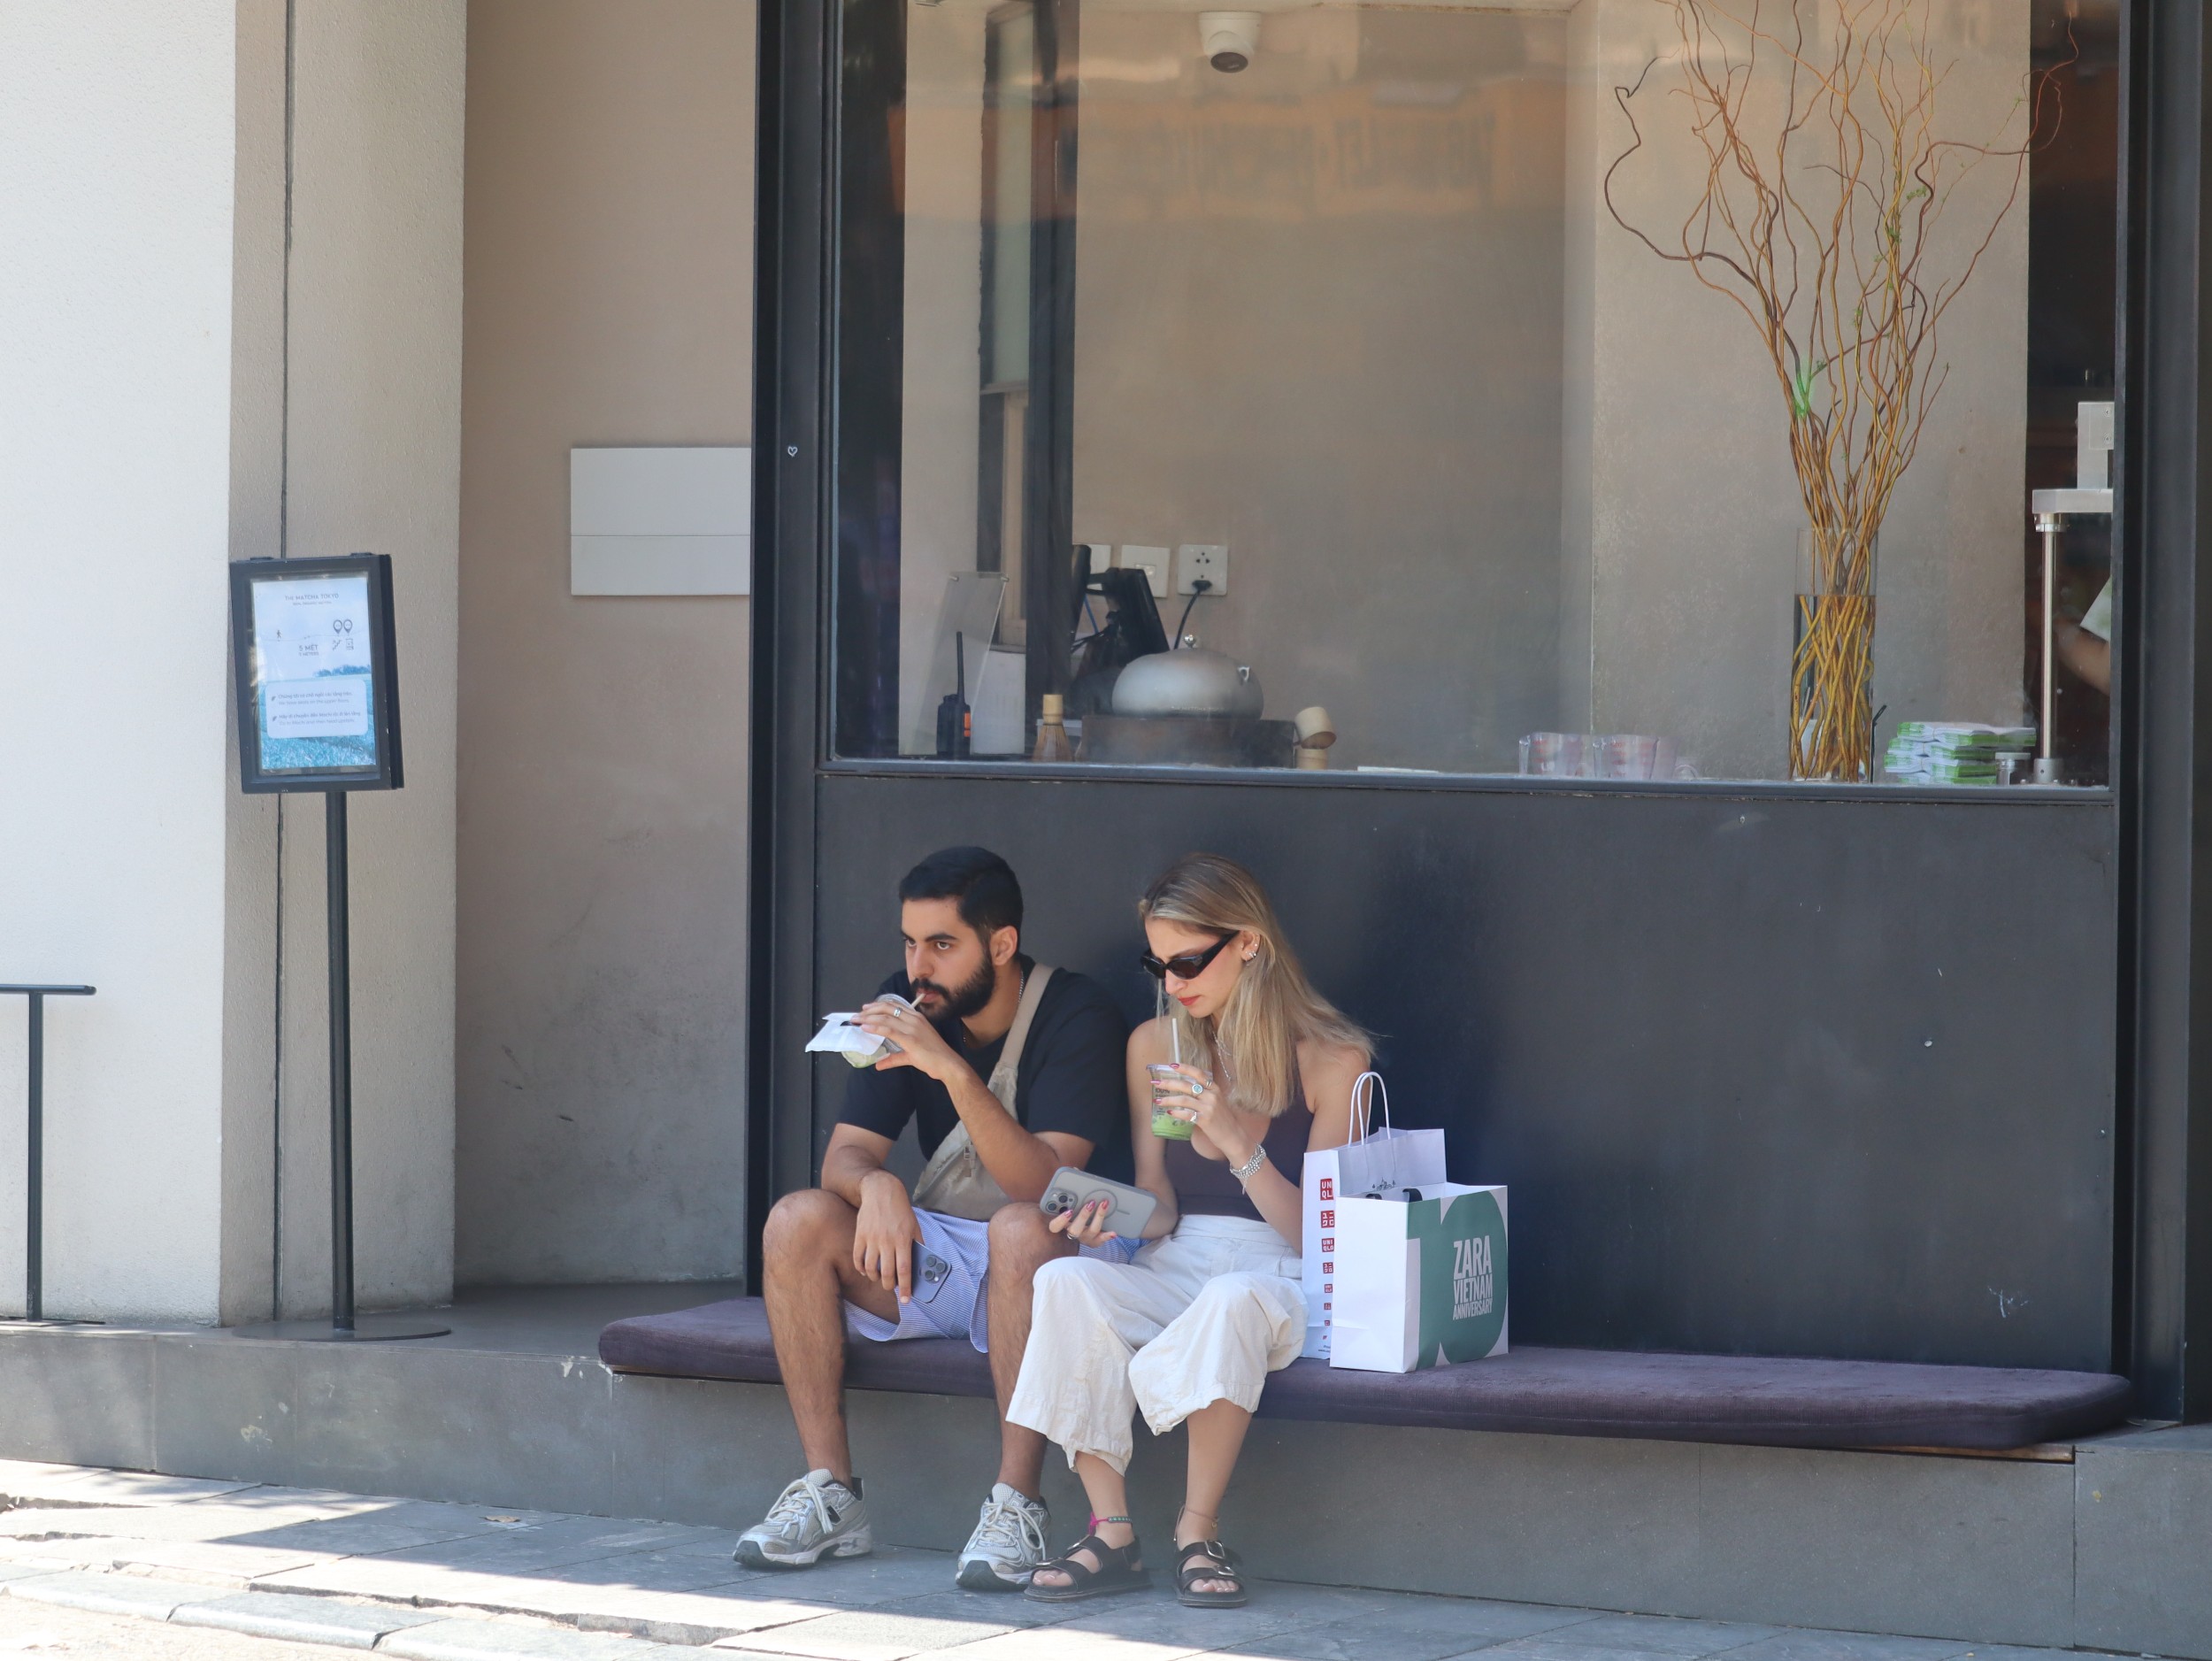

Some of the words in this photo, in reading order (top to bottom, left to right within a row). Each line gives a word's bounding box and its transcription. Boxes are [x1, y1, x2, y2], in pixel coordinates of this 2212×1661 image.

[1321, 1190, 1333, 1200] QL
[1454, 1235, 1493, 1280] ZARA
[1454, 1273, 1494, 1304] VIETNAM
[1453, 1297, 1494, 1320] ANNIVERSARY
